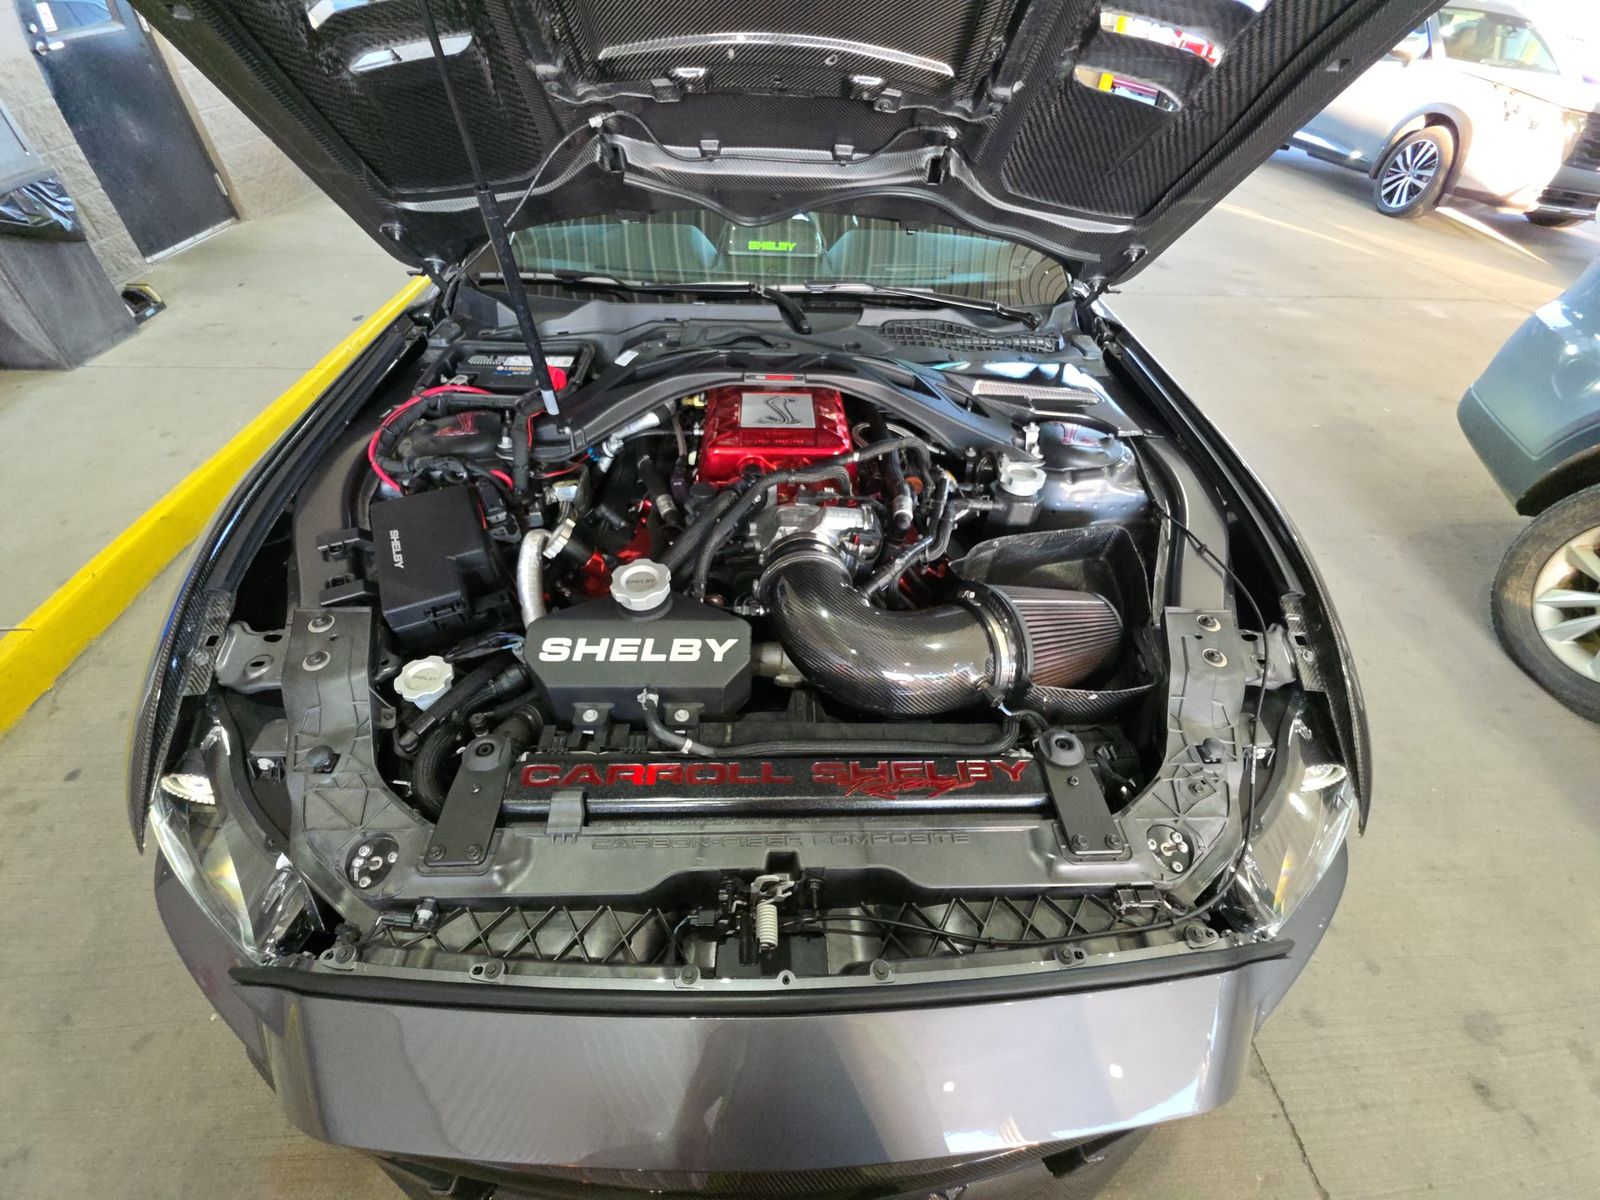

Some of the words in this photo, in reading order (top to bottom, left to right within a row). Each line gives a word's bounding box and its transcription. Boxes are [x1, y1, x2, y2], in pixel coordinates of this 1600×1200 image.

[748, 240, 797, 251] SHELBY
[389, 529, 405, 569] SHELBY
[538, 637, 739, 662] SHELBY
[520, 762, 794, 787] CARROLL
[811, 760, 1030, 785] SHELBY
[813, 832, 969, 847] COMPOSITE
